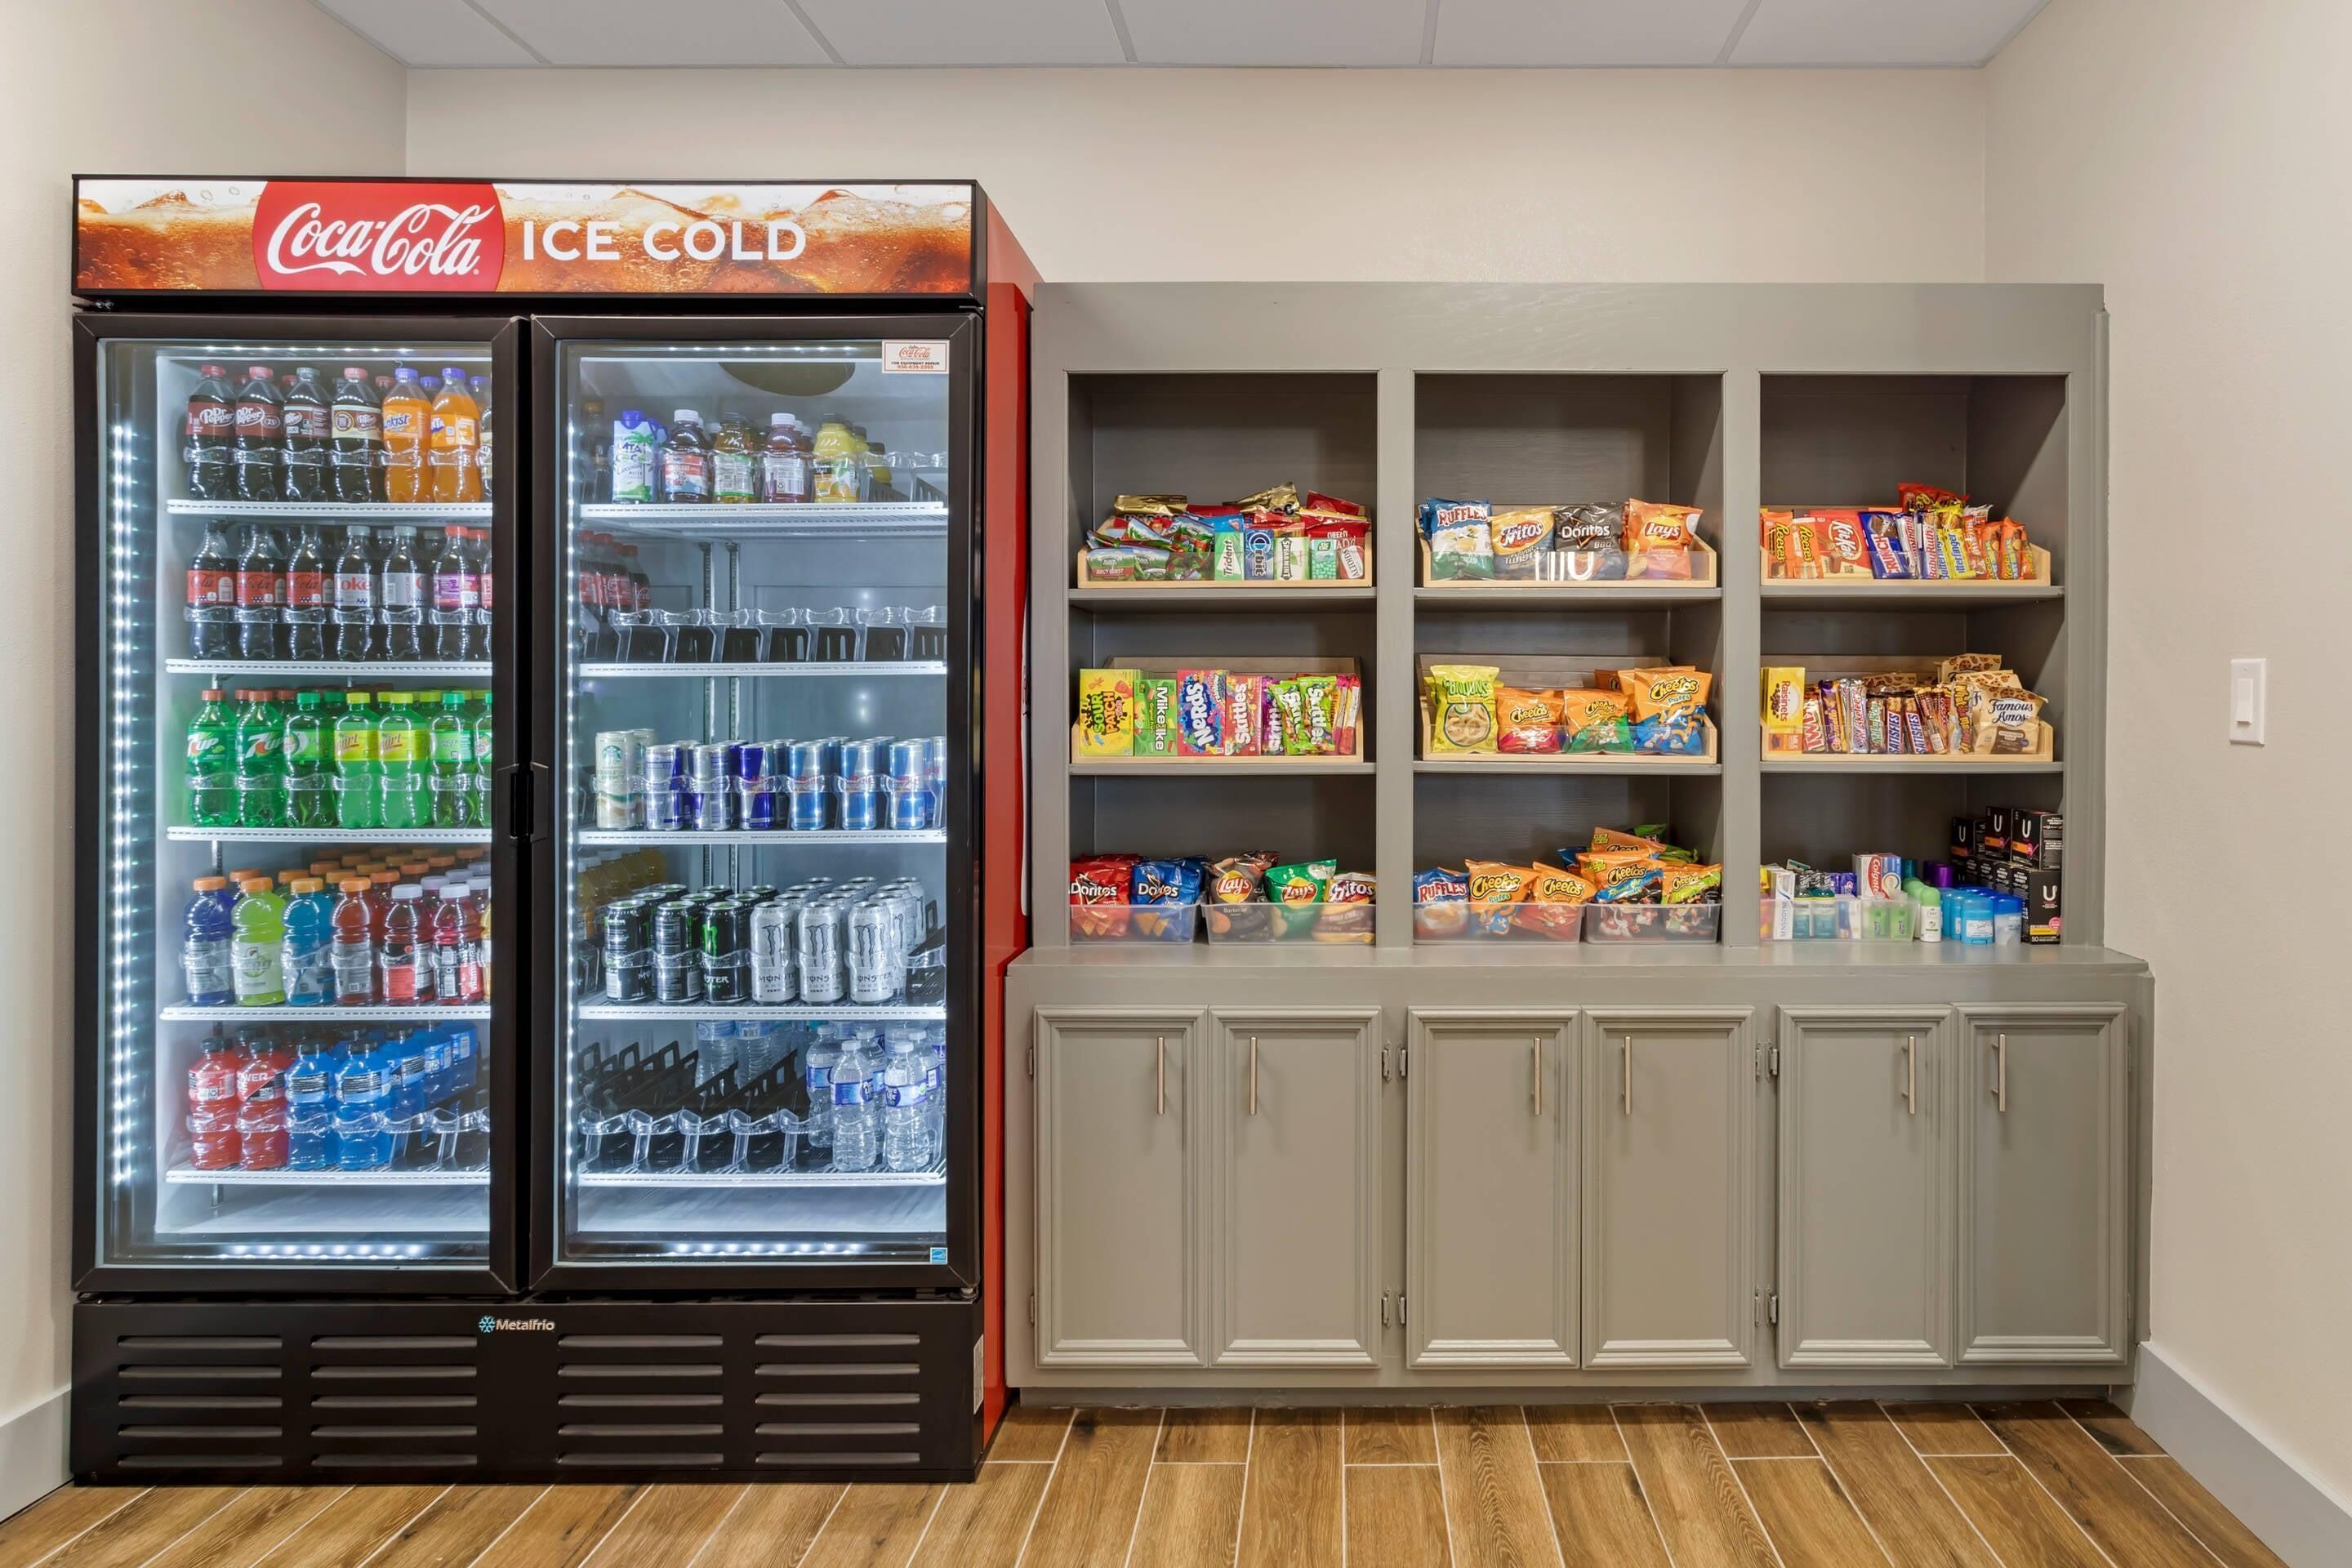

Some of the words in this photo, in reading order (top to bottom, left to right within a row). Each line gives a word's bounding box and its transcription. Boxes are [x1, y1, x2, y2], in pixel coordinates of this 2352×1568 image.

[266, 202, 495, 276] Coca-Cola
[523, 220, 621, 261] ICE
[643, 220, 807, 261] COLD
[203, 410, 234, 425] Pepper
[213, 408, 227, 416] Dr
[1437, 505, 1488, 528] RUFFLES
[1500, 522, 1544, 548] Fritos
[1561, 523, 1611, 539] Doritos
[1223, 540, 1233, 577] Trident
[1649, 675, 1700, 702] Cheetos
[1155, 686, 1168, 724] Mike
[1584, 698, 1615, 715] Cheetos
[1780, 680, 1791, 723] Raisinets
[1988, 697, 2034, 715] Famous
[1091, 693, 1105, 733] SOUR
[1102, 692, 1120, 735] PATCH
[1232, 683, 1252, 745] Skittles
[1510, 703, 1551, 724] Cheetos
[1992, 711, 2029, 724] Amos
[1888, 712, 1900, 754] SATISFIES
[1907, 713, 1927, 755] SATISFIES
[1993, 813, 2002, 833] U
[2021, 818, 2032, 838] U
[1471, 872, 1522, 899] Cheetos
[1607, 863, 1647, 887] Cheetos
[1672, 874, 1700, 891] Cheetos
[1872, 858, 1882, 896] Colgate
[1070, 882, 1118, 896] Doritos
[1330, 880, 1374, 902] Fritos
[1418, 881, 1466, 902] RUFFLES
[1487, 892, 1511, 902] Puffs
[1542, 878, 1585, 898] Cheetos
[2042, 884, 2058, 902] U
[496, 1319, 556, 1330] Metalfrio
